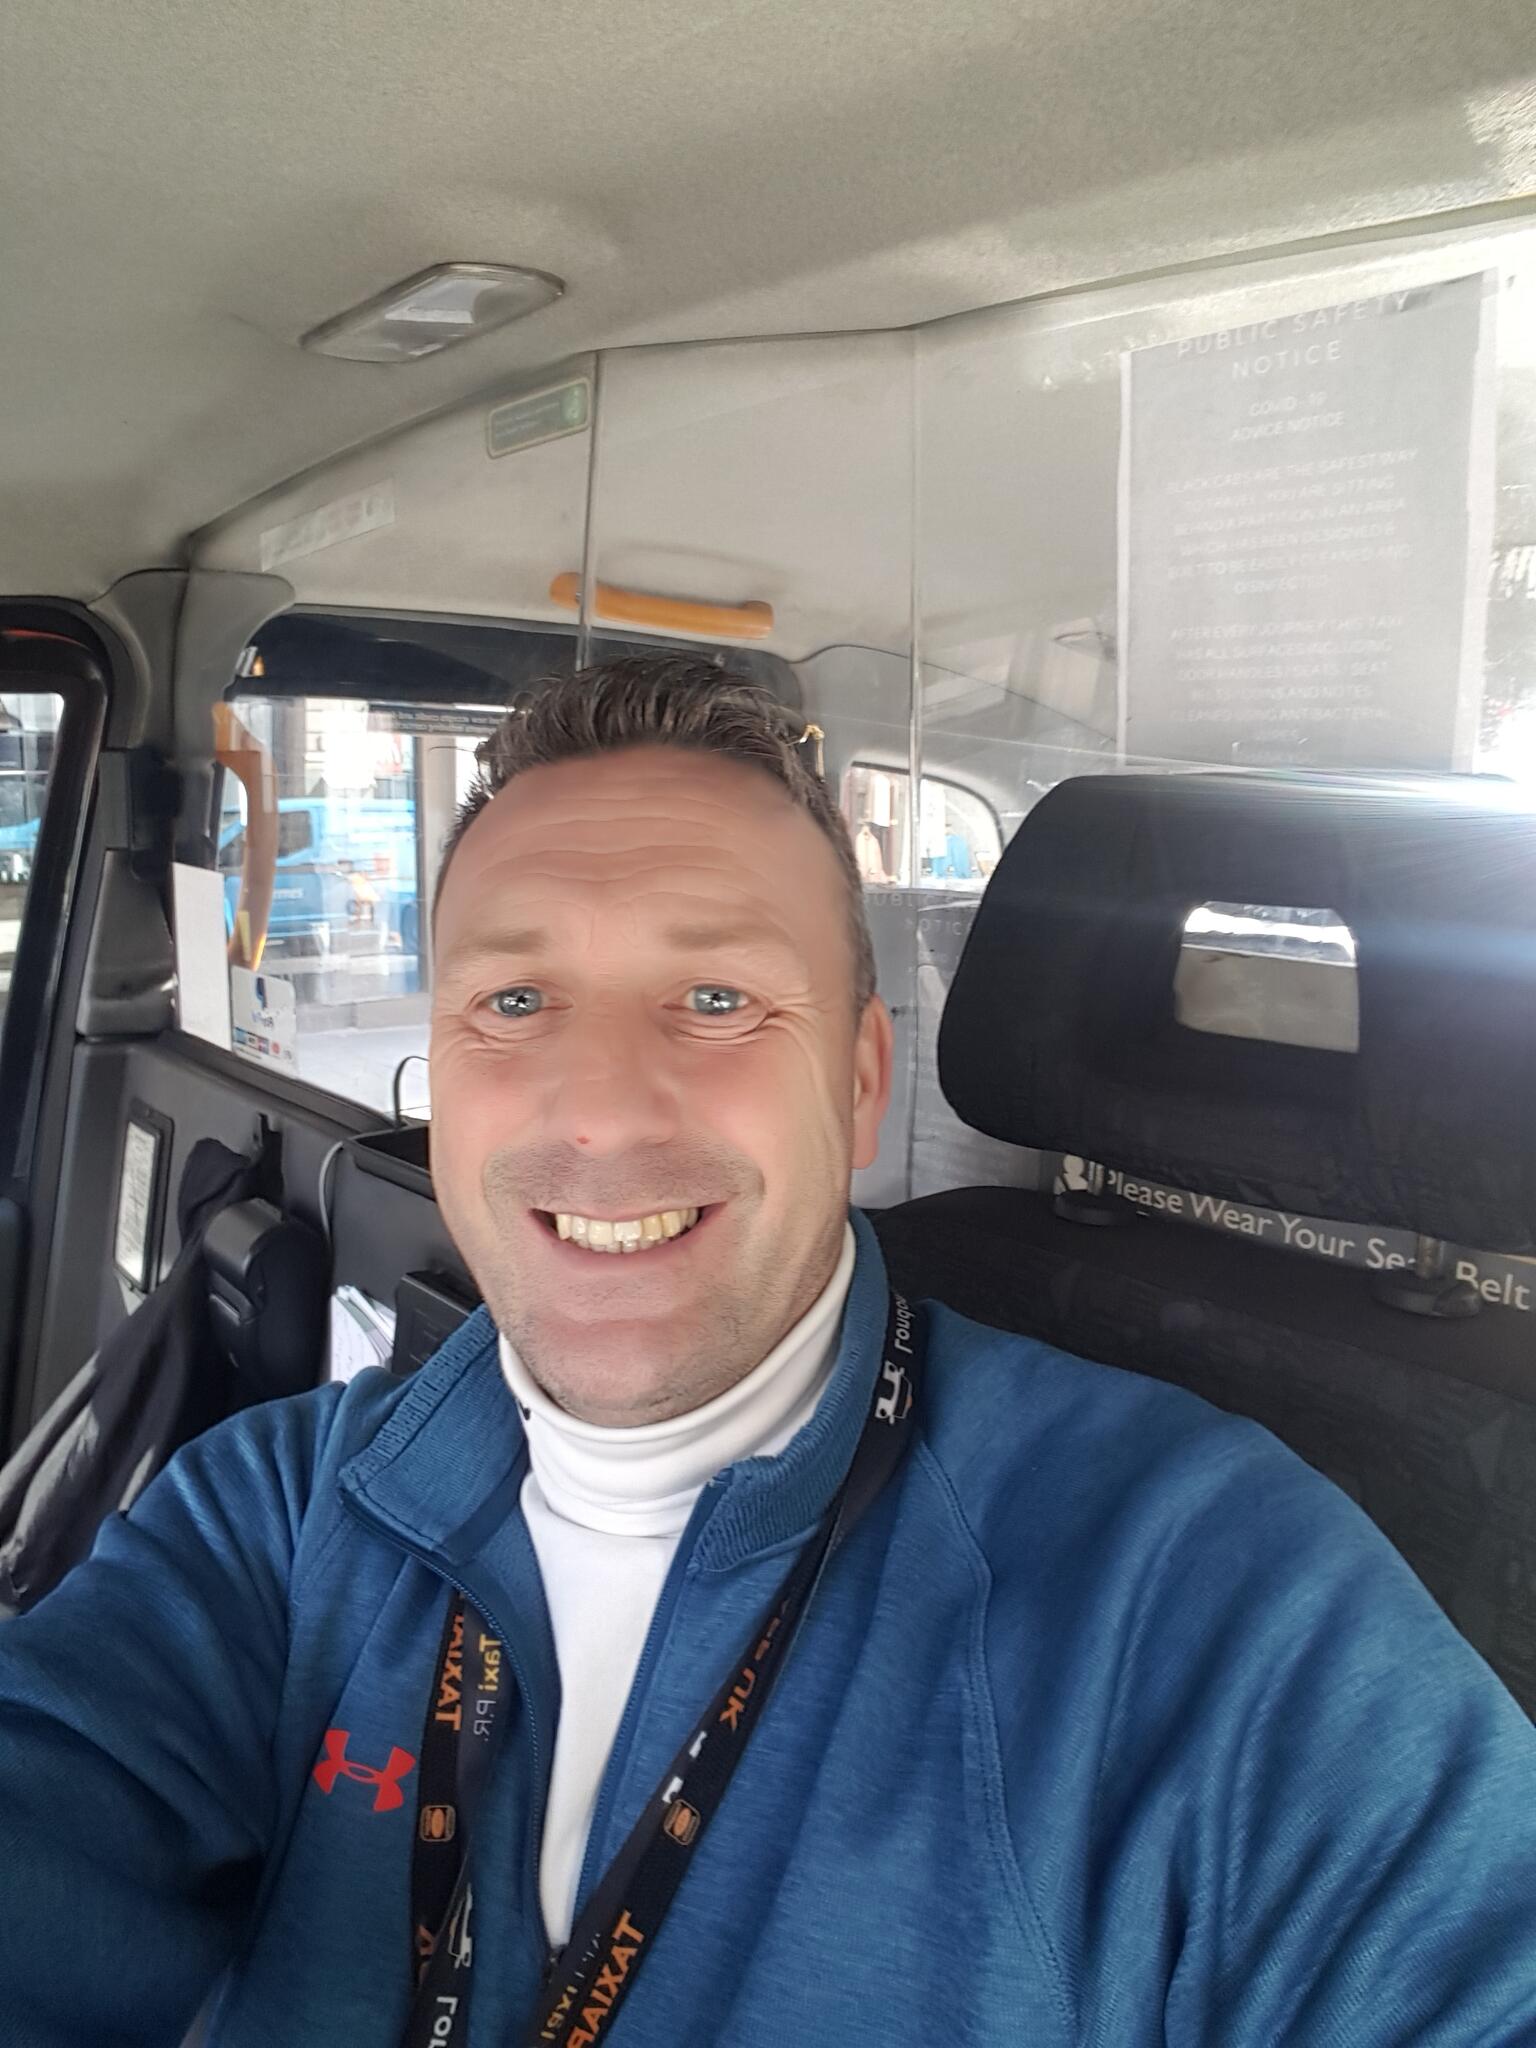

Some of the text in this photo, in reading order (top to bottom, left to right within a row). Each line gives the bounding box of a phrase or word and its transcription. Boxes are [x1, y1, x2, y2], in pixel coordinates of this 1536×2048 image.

[1177, 291, 1410, 359] PUBLIC SAFETY
[1231, 339, 1343, 380] NOTICE
[1189, 1191, 1274, 1237] Wear
[1278, 1213, 1356, 1260] Your
[1455, 1260, 1531, 1311] Belt
